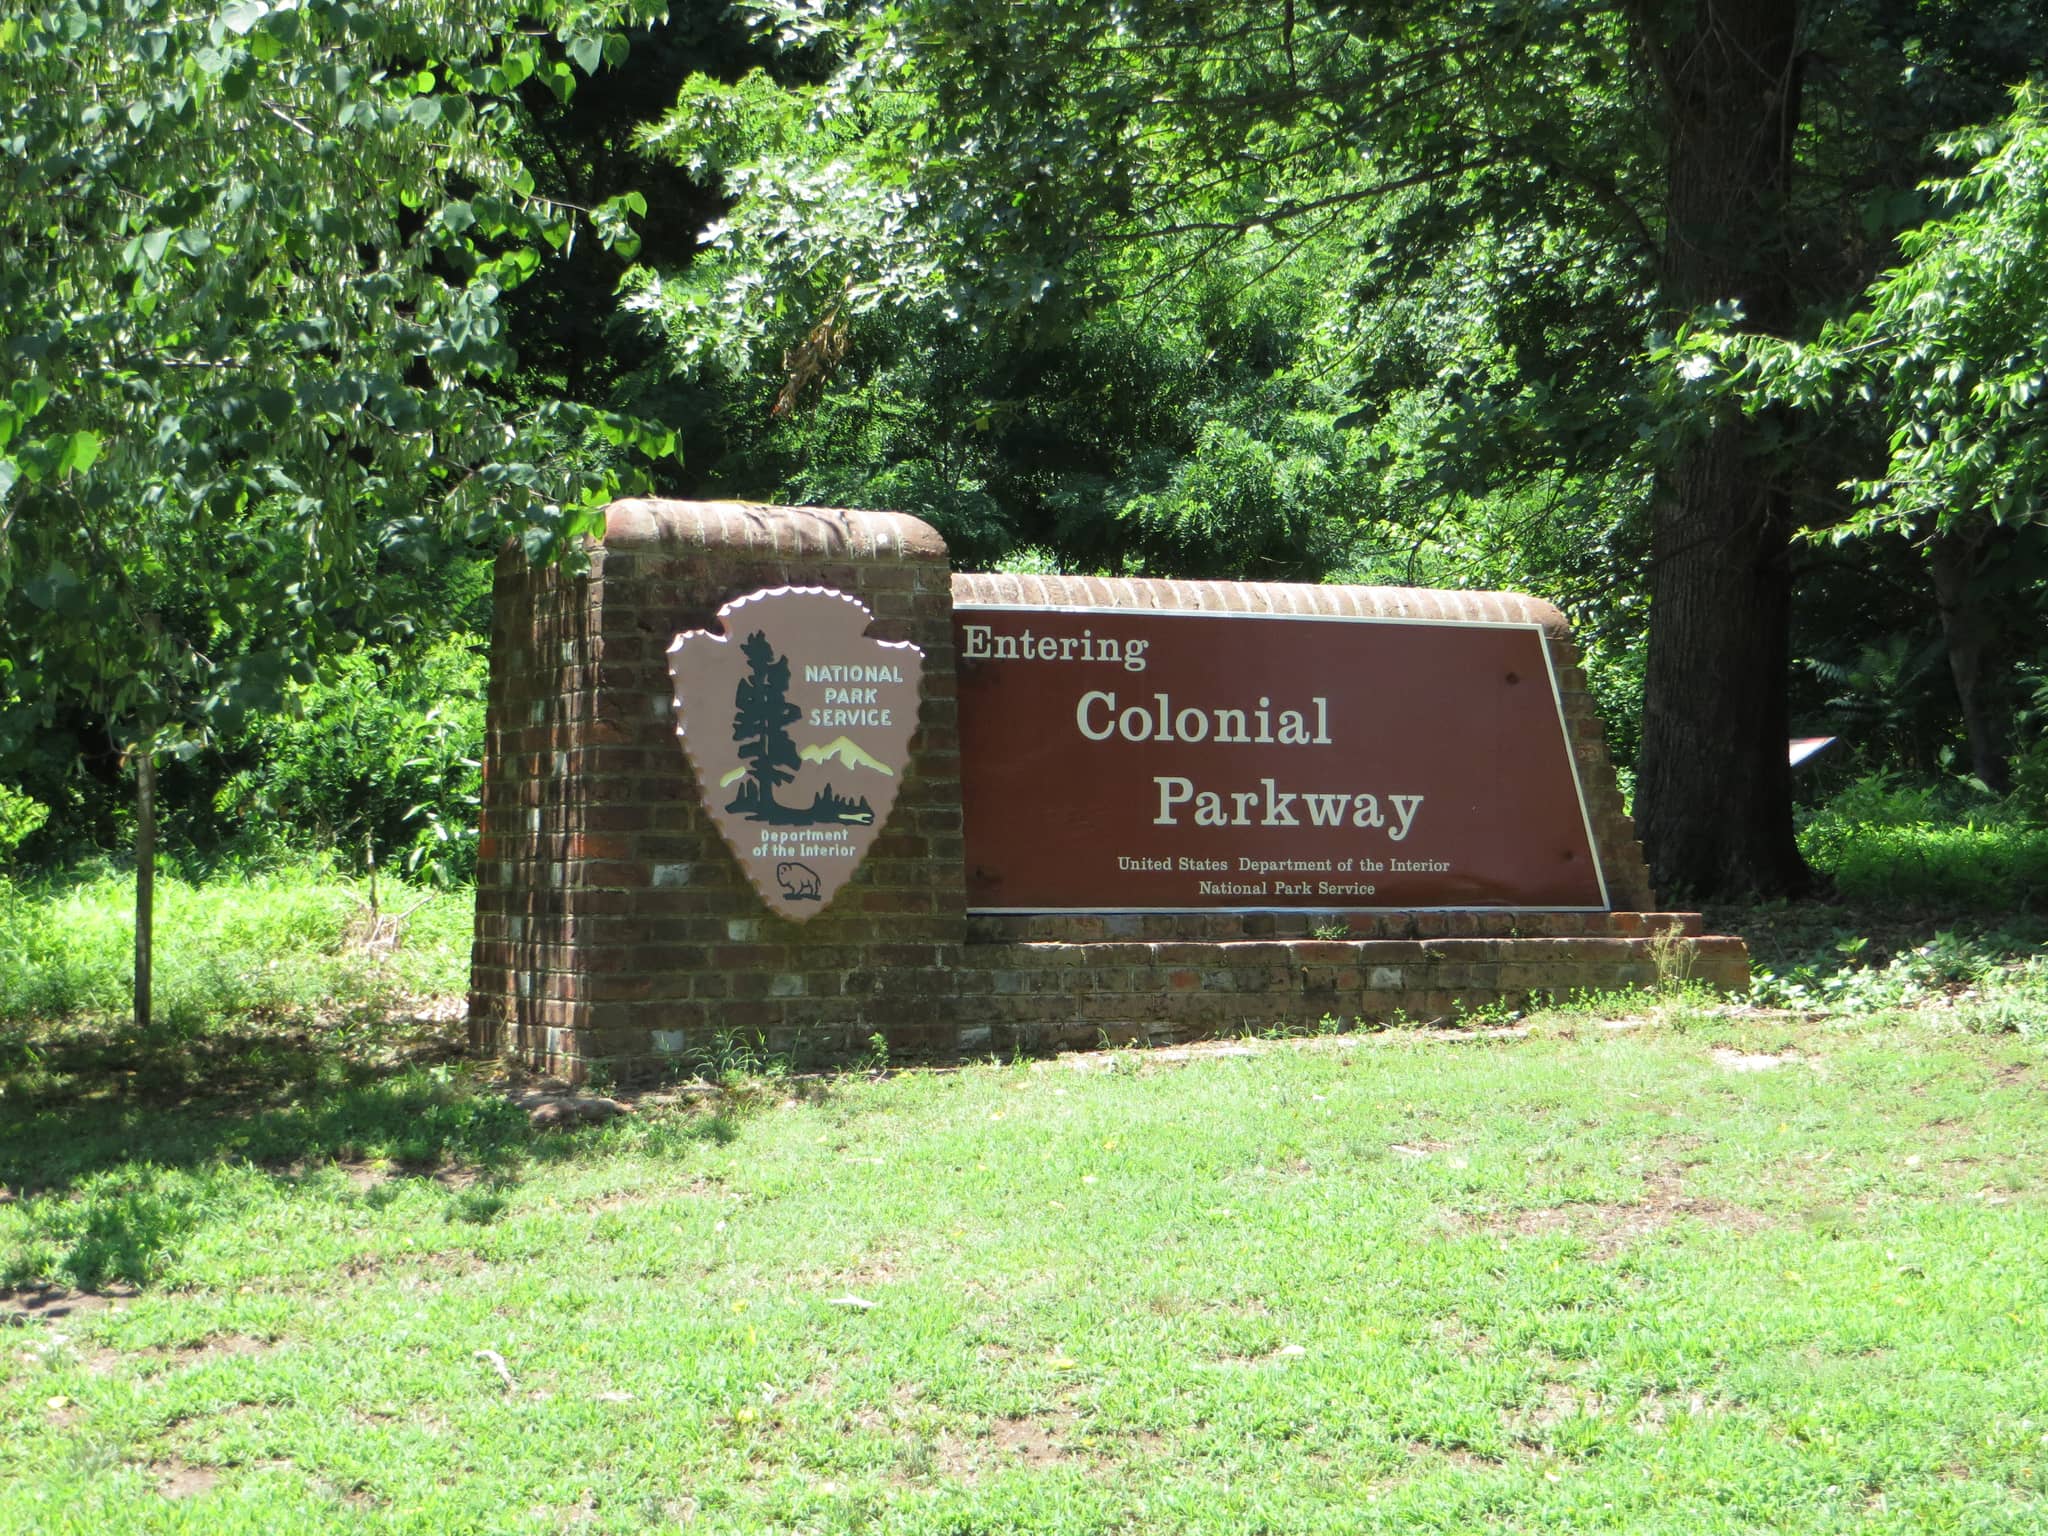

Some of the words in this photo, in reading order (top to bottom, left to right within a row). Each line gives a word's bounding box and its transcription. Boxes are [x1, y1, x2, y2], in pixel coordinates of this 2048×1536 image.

[962, 625, 1150, 672] Entering
[805, 665, 904, 683] NATIONAL
[824, 687, 878, 705] PARK
[809, 708, 892, 727] SERVICE
[1076, 690, 1333, 745] Colonial
[1153, 776, 1425, 841] Parkway
[760, 828, 849, 845] Department
[752, 843, 769, 857] of
[771, 842, 796, 857] the
[800, 843, 856, 857] Interior
[1117, 856, 1173, 871] United
[1178, 856, 1229, 871] States
[1238, 857, 1332, 875] Department
[1337, 857, 1353, 872] of
[1359, 858, 1384, 872] the
[1389, 858, 1451, 872] Interior
[1199, 880, 1267, 895] National
[1274, 880, 1313, 895] Park
[1318, 880, 1376, 896] Service
